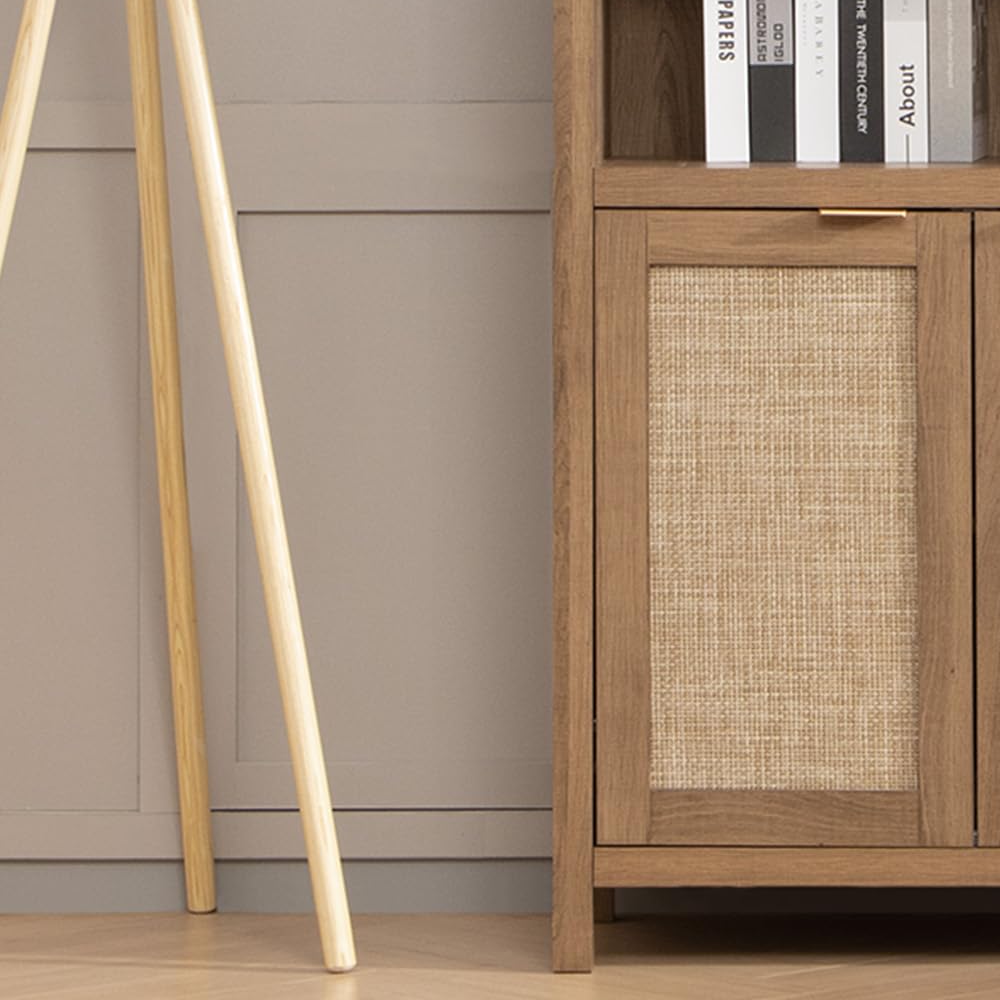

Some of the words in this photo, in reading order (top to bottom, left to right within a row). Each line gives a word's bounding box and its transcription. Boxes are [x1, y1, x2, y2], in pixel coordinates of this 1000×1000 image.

[718, 0, 735, 61] PAPERS
[774, 23, 784, 62] IGLOO
[856, 24, 868, 83] TWENTIETH
[856, 84, 868, 135] CENTURY
[898, 63, 915, 127] About
